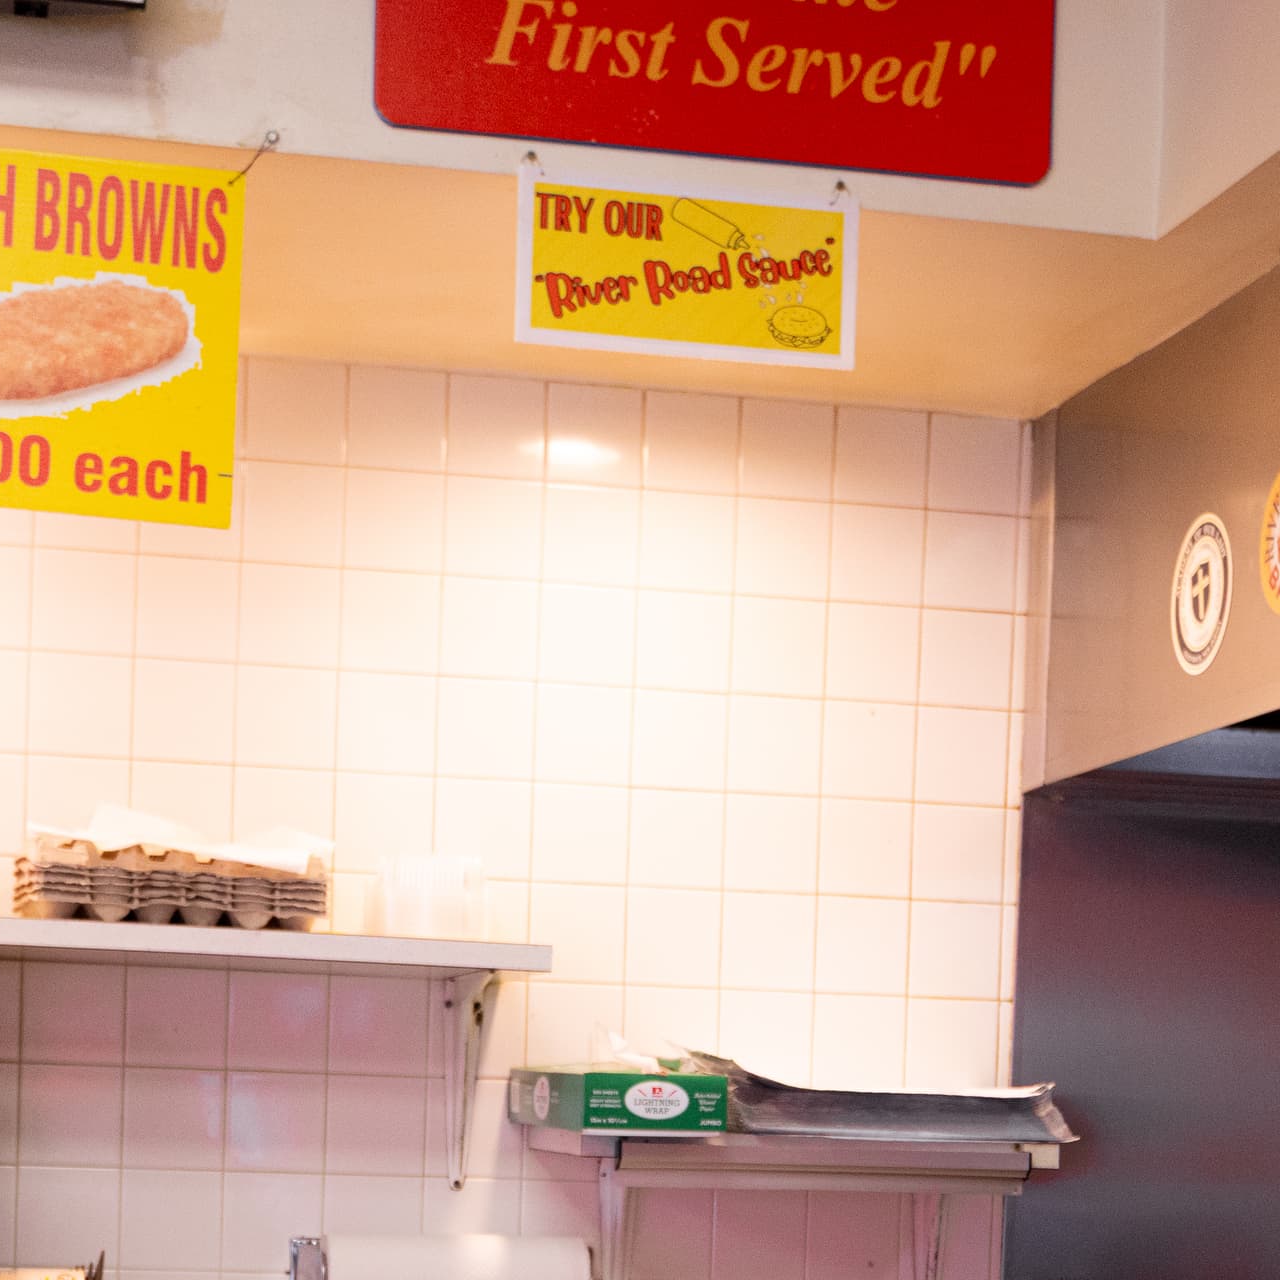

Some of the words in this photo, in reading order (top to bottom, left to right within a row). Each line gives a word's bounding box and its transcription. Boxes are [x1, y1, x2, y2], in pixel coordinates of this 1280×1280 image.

[485, 0, 677, 81] First
[34, 168, 228, 274] BROWNS
[536, 192, 595, 234] TRY
[604, 200, 664, 242] OUR
[643, 251, 733, 306] Road
[74, 450, 208, 504] each
[634, 1099, 680, 1107] LIGHTNING
[645, 1107, 670, 1115] WRAP
